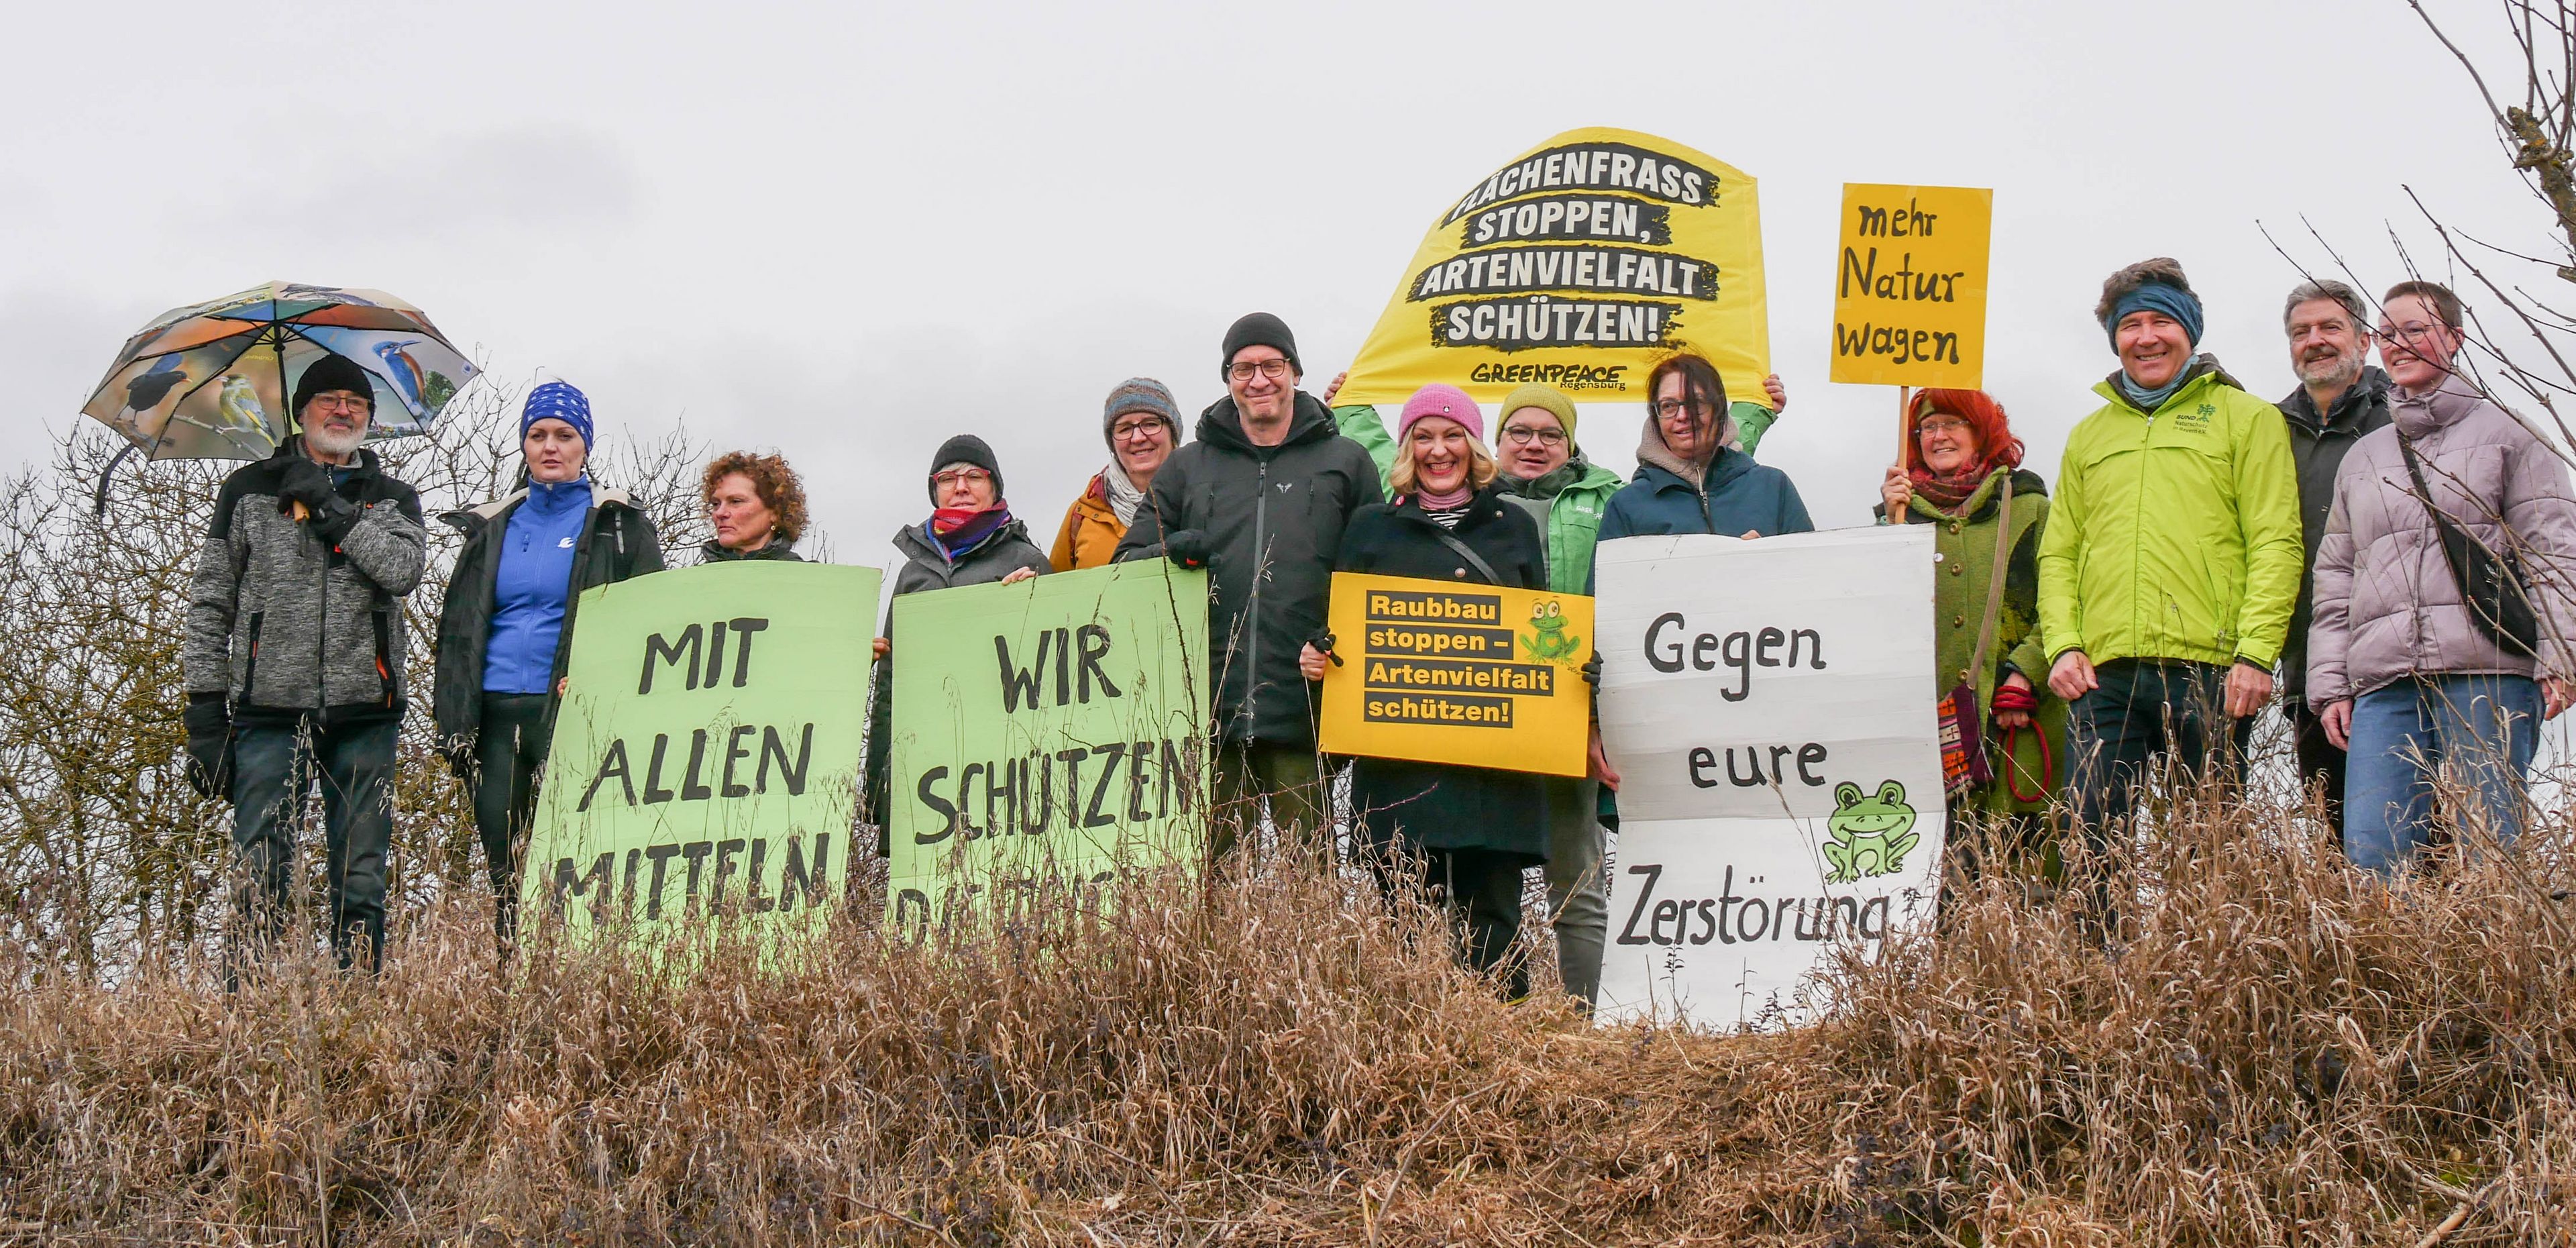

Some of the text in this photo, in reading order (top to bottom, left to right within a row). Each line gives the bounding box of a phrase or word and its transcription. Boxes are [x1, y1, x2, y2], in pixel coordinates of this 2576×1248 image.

[1450, 151, 1702, 221] FLÄCHENFRASS
[1475, 201, 1650, 243] STOPPEN,
[1858, 197, 1937, 238] mehr
[1419, 251, 1699, 296] ARTENVIELFALT
[1841, 246, 1964, 302] Natur
[1448, 296, 1658, 342] SCHÜTZEN!
[1470, 363, 1627, 382] GREENPEACE
[1560, 381, 1625, 391] Regensburg
[1371, 595, 1497, 620] Raubbau
[639, 618, 769, 695] MIT
[1370, 628, 1485, 653] stoppen
[1644, 612, 1827, 702] Gegen
[994, 624, 1122, 713] WIR
[1368, 662, 1550, 691] Artenvielfalt
[1368, 698, 1509, 722] schützen!
[577, 723, 814, 812] ALLEN
[1688, 742, 1827, 788] eure
[915, 736, 1192, 845] SCHÜTZEN
[551, 833, 830, 923] MITTELN
[1617, 864, 1890, 966] Zerstörung
